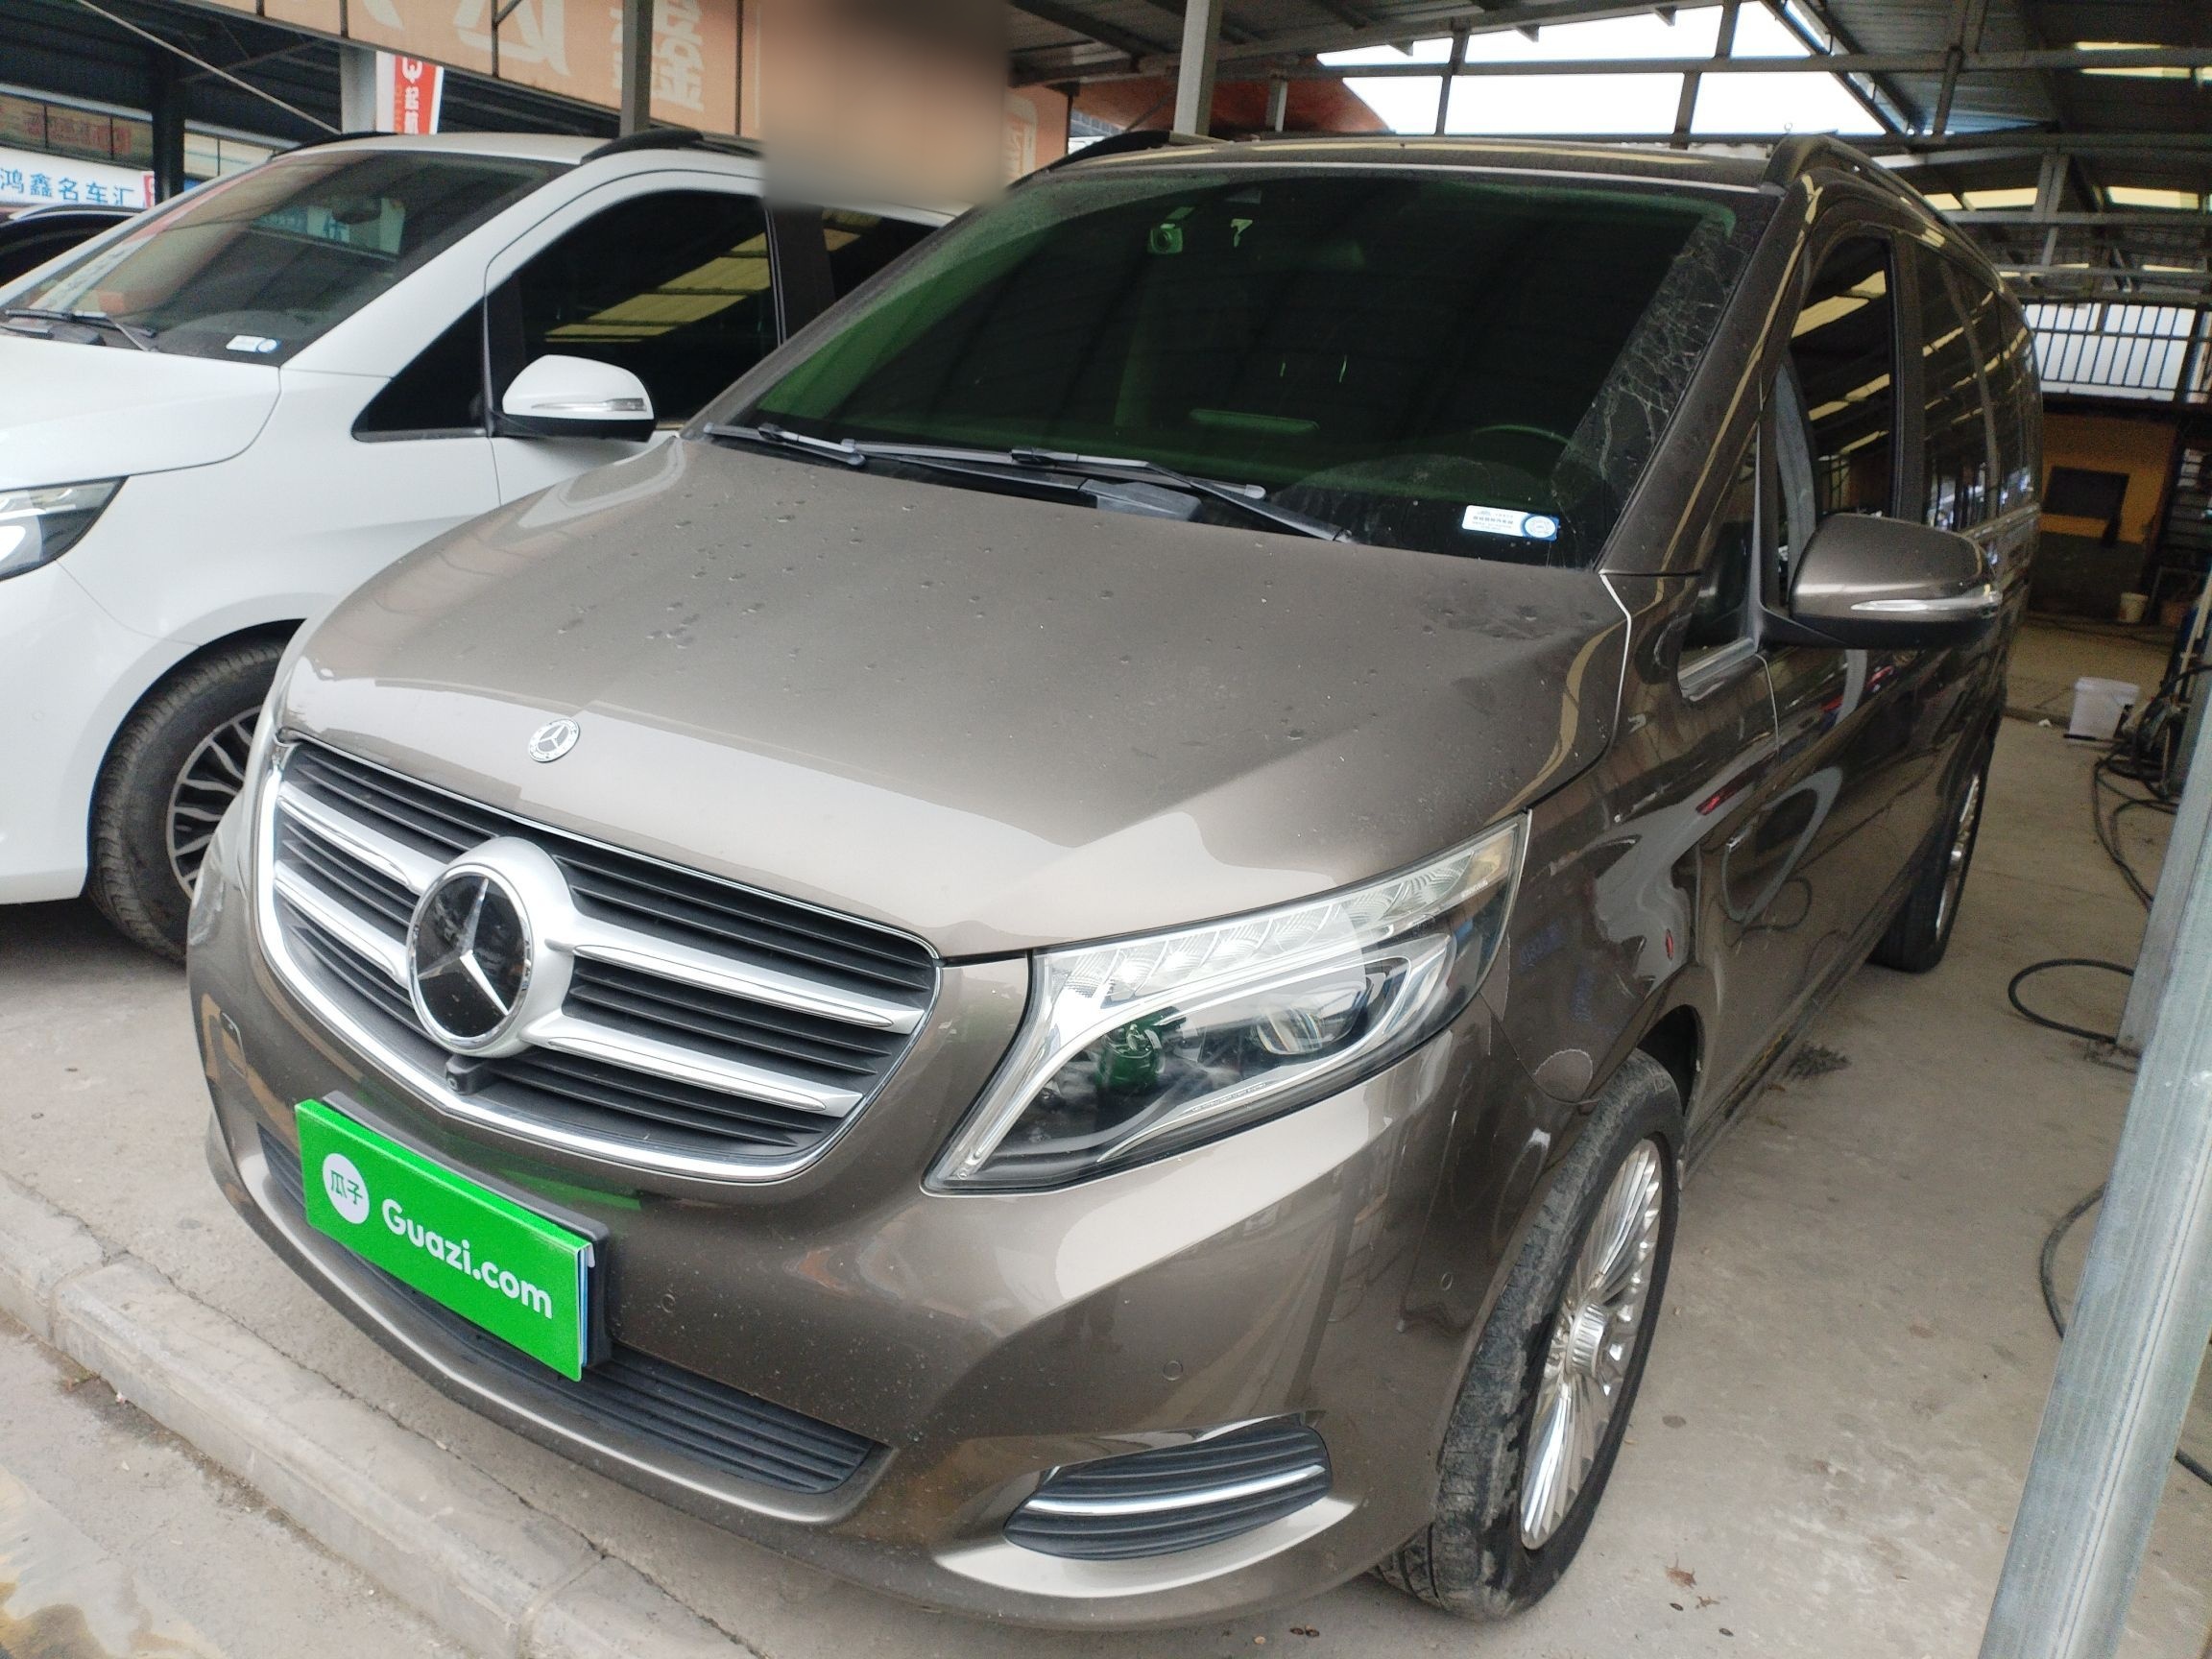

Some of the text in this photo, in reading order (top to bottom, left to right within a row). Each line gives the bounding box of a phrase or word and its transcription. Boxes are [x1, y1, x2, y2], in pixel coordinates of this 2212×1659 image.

[0, 168, 134, 205] 鸿鑫名车汇
[330, 1170, 363, 1206] 瓜子
[382, 1198, 553, 1319] Guazi.com
